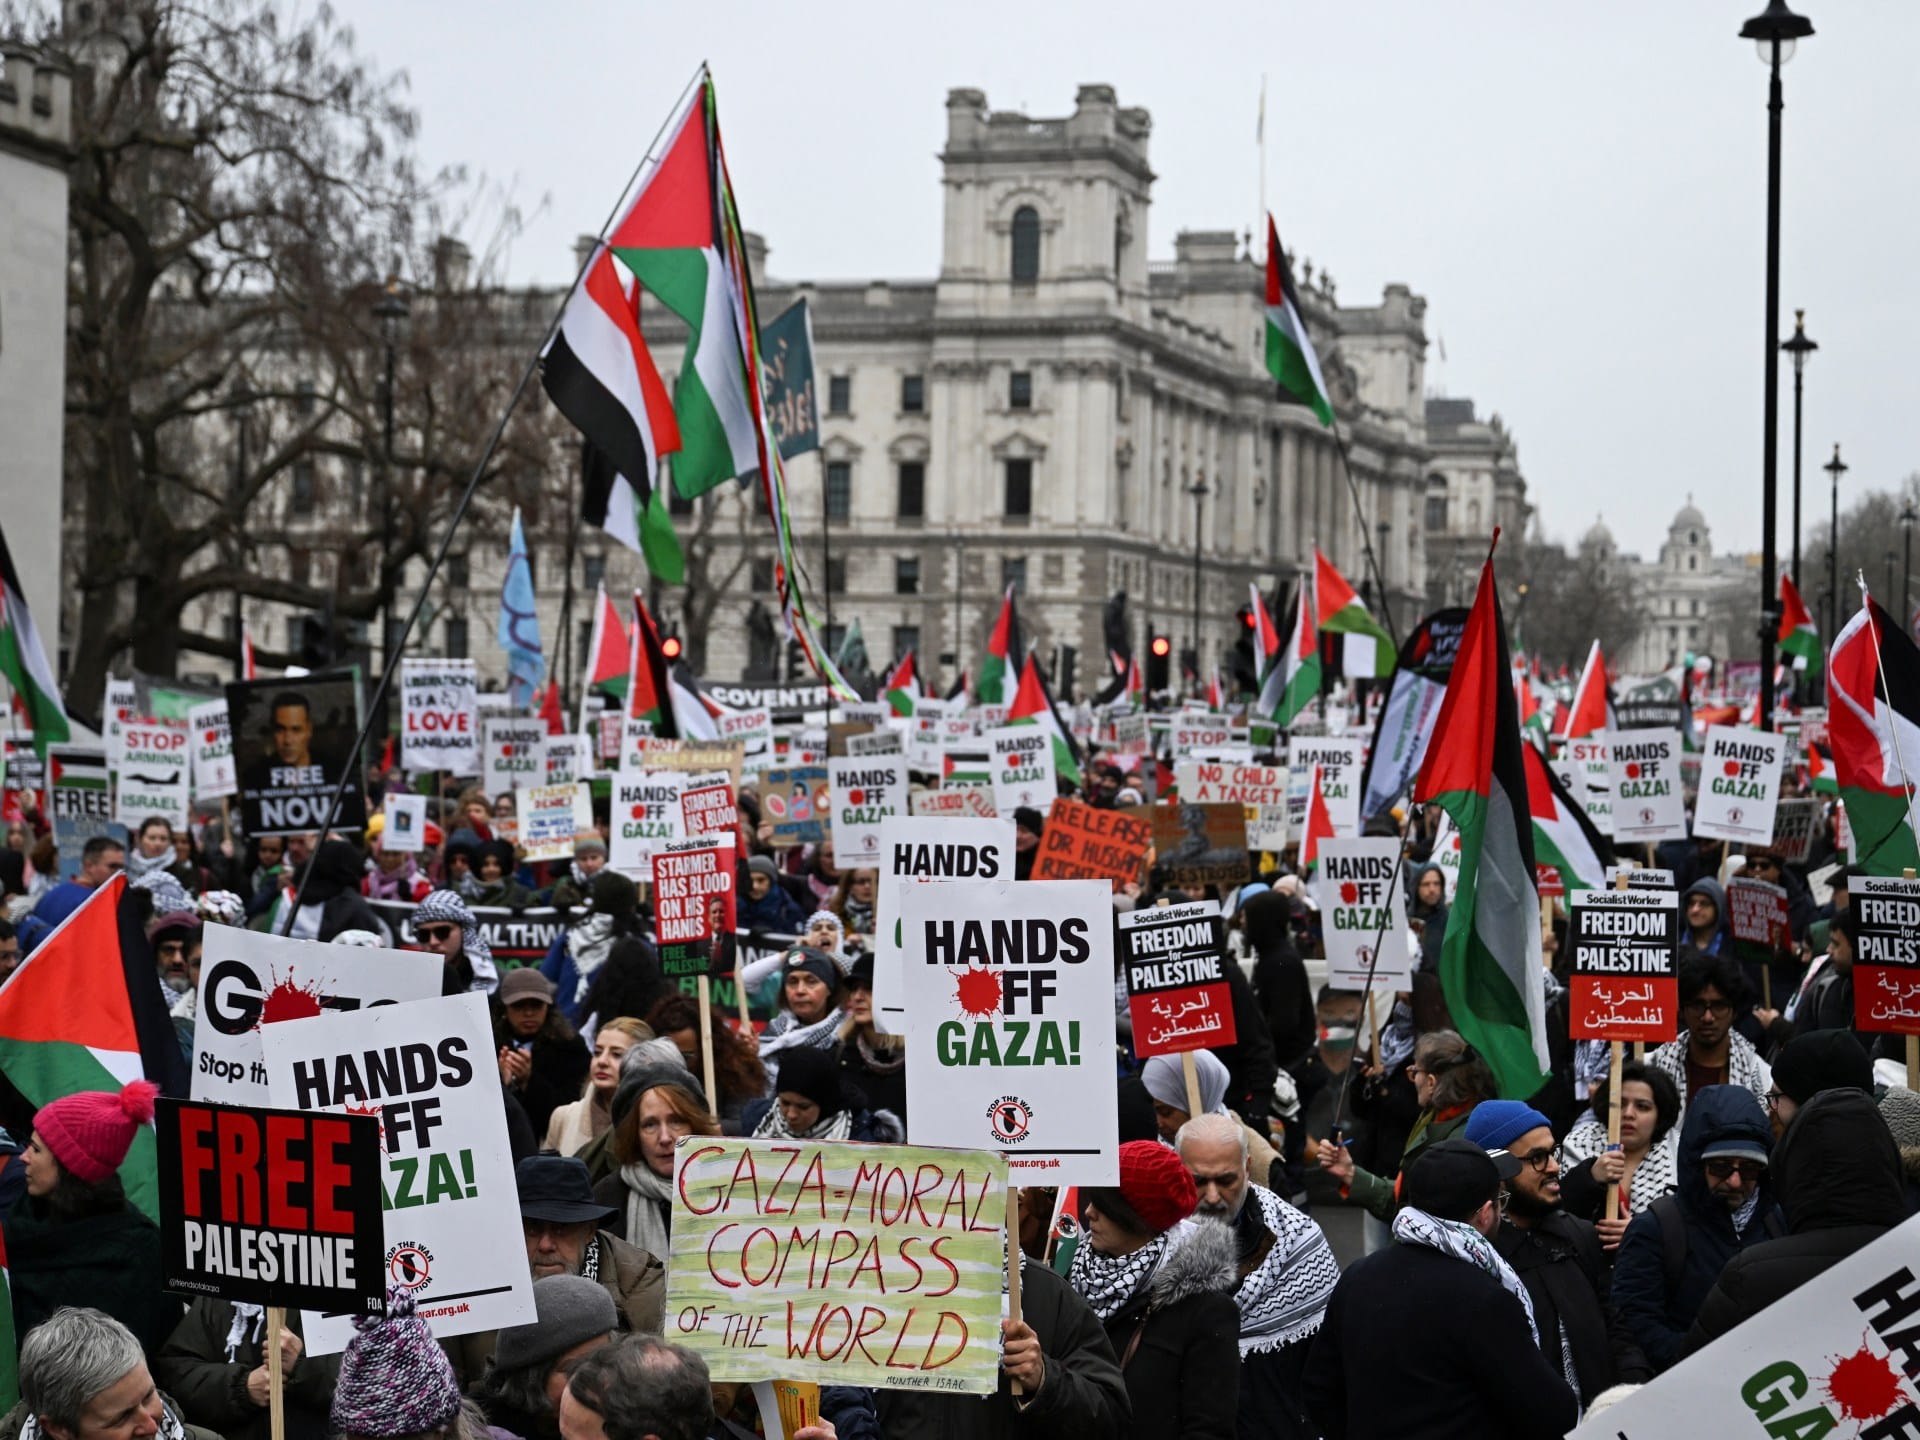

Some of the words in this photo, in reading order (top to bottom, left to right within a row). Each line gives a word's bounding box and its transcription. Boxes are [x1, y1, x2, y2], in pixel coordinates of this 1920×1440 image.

[711, 686, 828, 707] COVENTR
[407, 711, 469, 732] LOVE
[725, 713, 766, 732] STOP
[126, 732, 185, 750] STOP
[492, 730, 540, 742] HANDS
[996, 736, 1045, 753] HANDS
[1178, 731, 1227, 745] STOP
[125, 752, 184, 765] ARMING
[1299, 750, 1352, 764] HANDS
[1613, 742, 1669, 761] HANDS
[1714, 739, 1775, 764] HANDS
[270, 765, 323, 785] FREE
[495, 759, 537, 772] GAZA!
[1002, 767, 1045, 784] GAZA!
[1198, 765, 1222, 782] NO
[1233, 768, 1276, 784] CHILD
[837, 769, 896, 787] HANDS
[1620, 779, 1670, 798] GAZA!
[1712, 776, 1766, 801] GAZA!
[620, 787, 677, 803] HANDS
[683, 789, 728, 814] STARMER
[1198, 786, 1210, 799] A
[1219, 785, 1282, 805] TARGET
[1323, 784, 1348, 798] ZA!
[53, 789, 109, 817] FREE
[121, 795, 181, 811] ISRAEL
[260, 797, 343, 828] NOW
[706, 807, 737, 826] BLOOD
[1052, 800, 1151, 846] RELEASE
[622, 823, 674, 839] GAZA!
[894, 844, 999, 878] HANDS
[1047, 830, 1074, 854] DR
[1081, 841, 1141, 875] HUSSAM
[657, 853, 716, 878] STARMER
[1326, 857, 1393, 880] HANDS
[659, 878, 687, 898] HAS
[690, 872, 731, 893] BLOOD
[1865, 881, 1908, 894] Socialist
[660, 899, 681, 919] ON
[685, 896, 704, 917] HIS
[1587, 894, 1627, 906] Socialist
[1627, 895, 1662, 906] Worker
[1134, 911, 1172, 924] Socialist
[1172, 906, 1205, 919] Worker
[1334, 907, 1393, 931] GAZA!
[1860, 899, 1920, 926] FREED
[661, 917, 704, 940] HANDS
[1581, 911, 1666, 937] FREEDOM
[1901, 925, 1915, 938] for
[925, 918, 1090, 965] HANDS
[1130, 921, 1213, 955] FREEDOM
[1616, 935, 1631, 948] for
[662, 945, 686, 960] FREE
[1168, 950, 1182, 961] for
[1858, 935, 1920, 964] PALES
[1576, 948, 1671, 973] PALESTINE
[1131, 955, 1222, 990] PALESTINE
[1592, 982, 1654, 1006] الحرية
[1152, 992, 1209, 1018] الحرية
[1584, 1006, 1663, 1028] لفلسطين
[1148, 1012, 1222, 1045] لفلسطين
[937, 1020, 1081, 1067] GAZA!
[200, 1051, 245, 1083] Stop
[250, 1061, 268, 1086] th
[293, 1036, 473, 1110] HANDS
[986, 1099, 1000, 1118] STOP
[1001, 1095, 1018, 1103] THE
[1020, 1099, 1034, 1118] WAR
[990, 1130, 1030, 1144] COALITION
[178, 1107, 355, 1234] FREE
[1008, 1159, 1060, 1169] war.org.uk
[383, 1149, 478, 1211] ZA!
[184, 1220, 356, 1289] PALESTINE
[386, 1246, 396, 1268] STOP
[418, 1243, 434, 1262] WAR
[707, 1223, 960, 1297] COMPASS
[411, 1276, 433, 1294] ITION
[367, 1297, 383, 1310] FOA
[416, 1303, 470, 1318] war.org.uk
[678, 1304, 716, 1333] OF
[722, 1313, 769, 1348] THE
[786, 1300, 968, 1370] WORLD
[886, 1375, 930, 1387] MUNTHER
[935, 1377, 965, 1391] ISAAC
